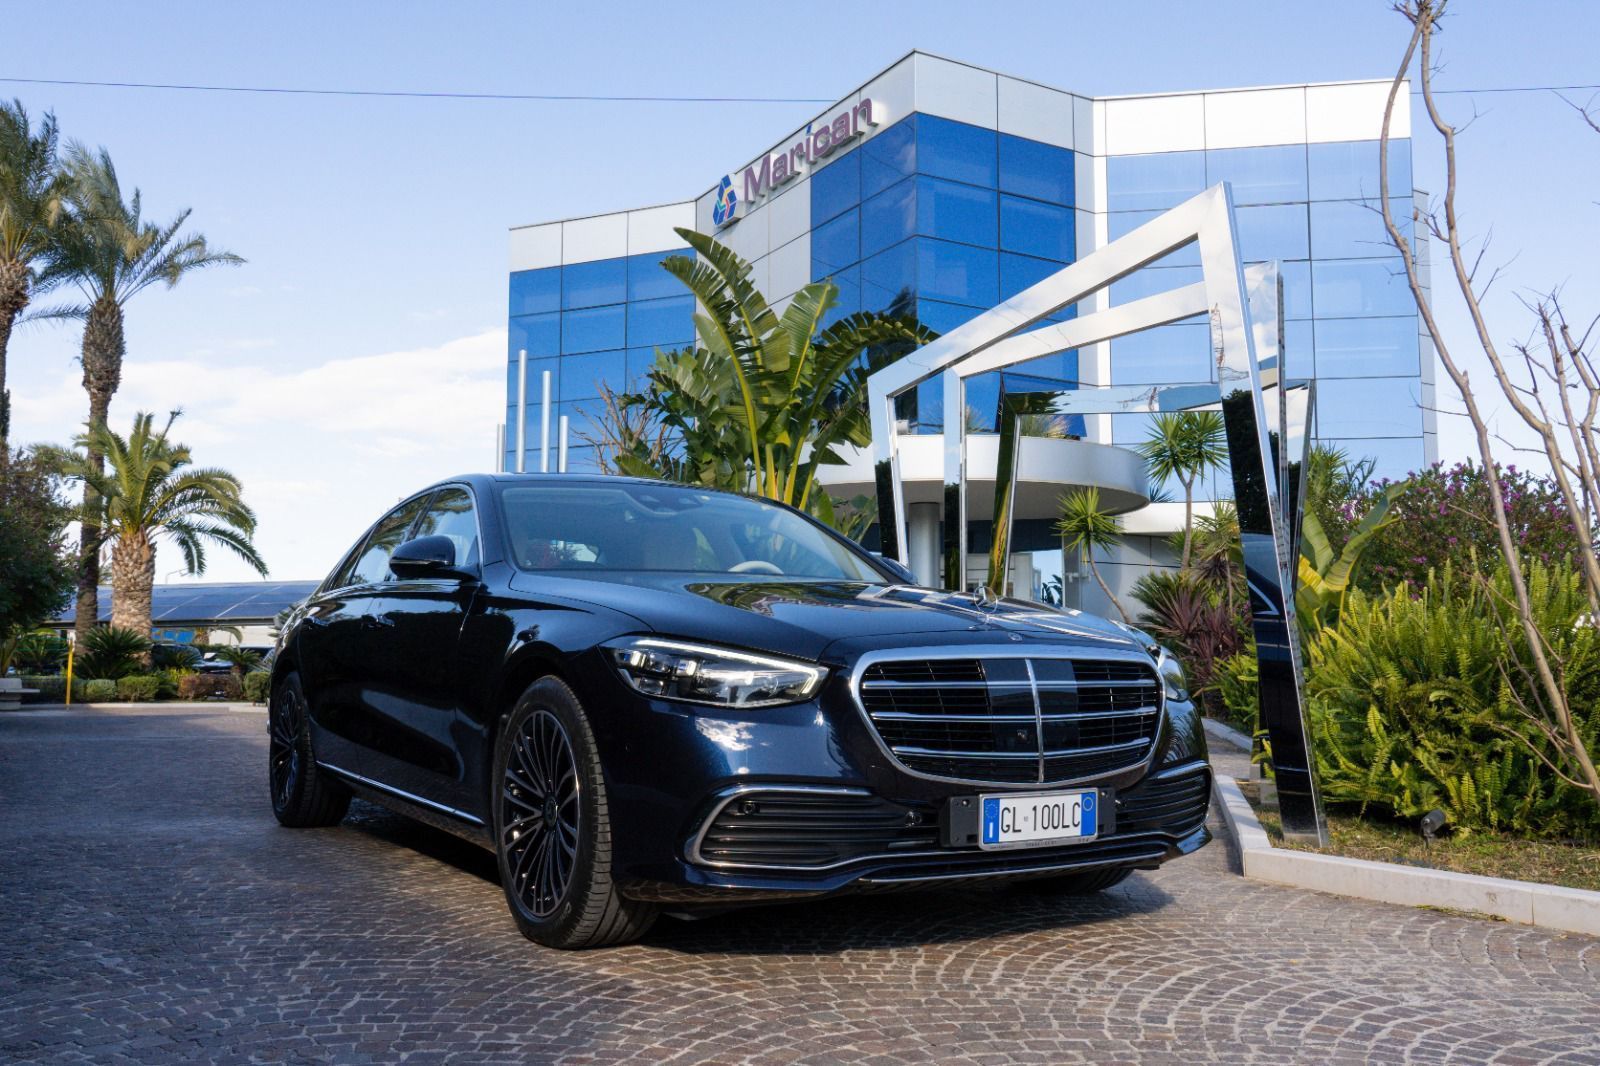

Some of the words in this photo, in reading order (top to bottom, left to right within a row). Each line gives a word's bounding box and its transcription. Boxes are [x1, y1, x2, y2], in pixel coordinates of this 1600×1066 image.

[744, 97, 873, 203] Marican
[989, 822, 994, 839] I
[1000, 806, 1022, 834] GL
[1031, 801, 1081, 832] 100LC
